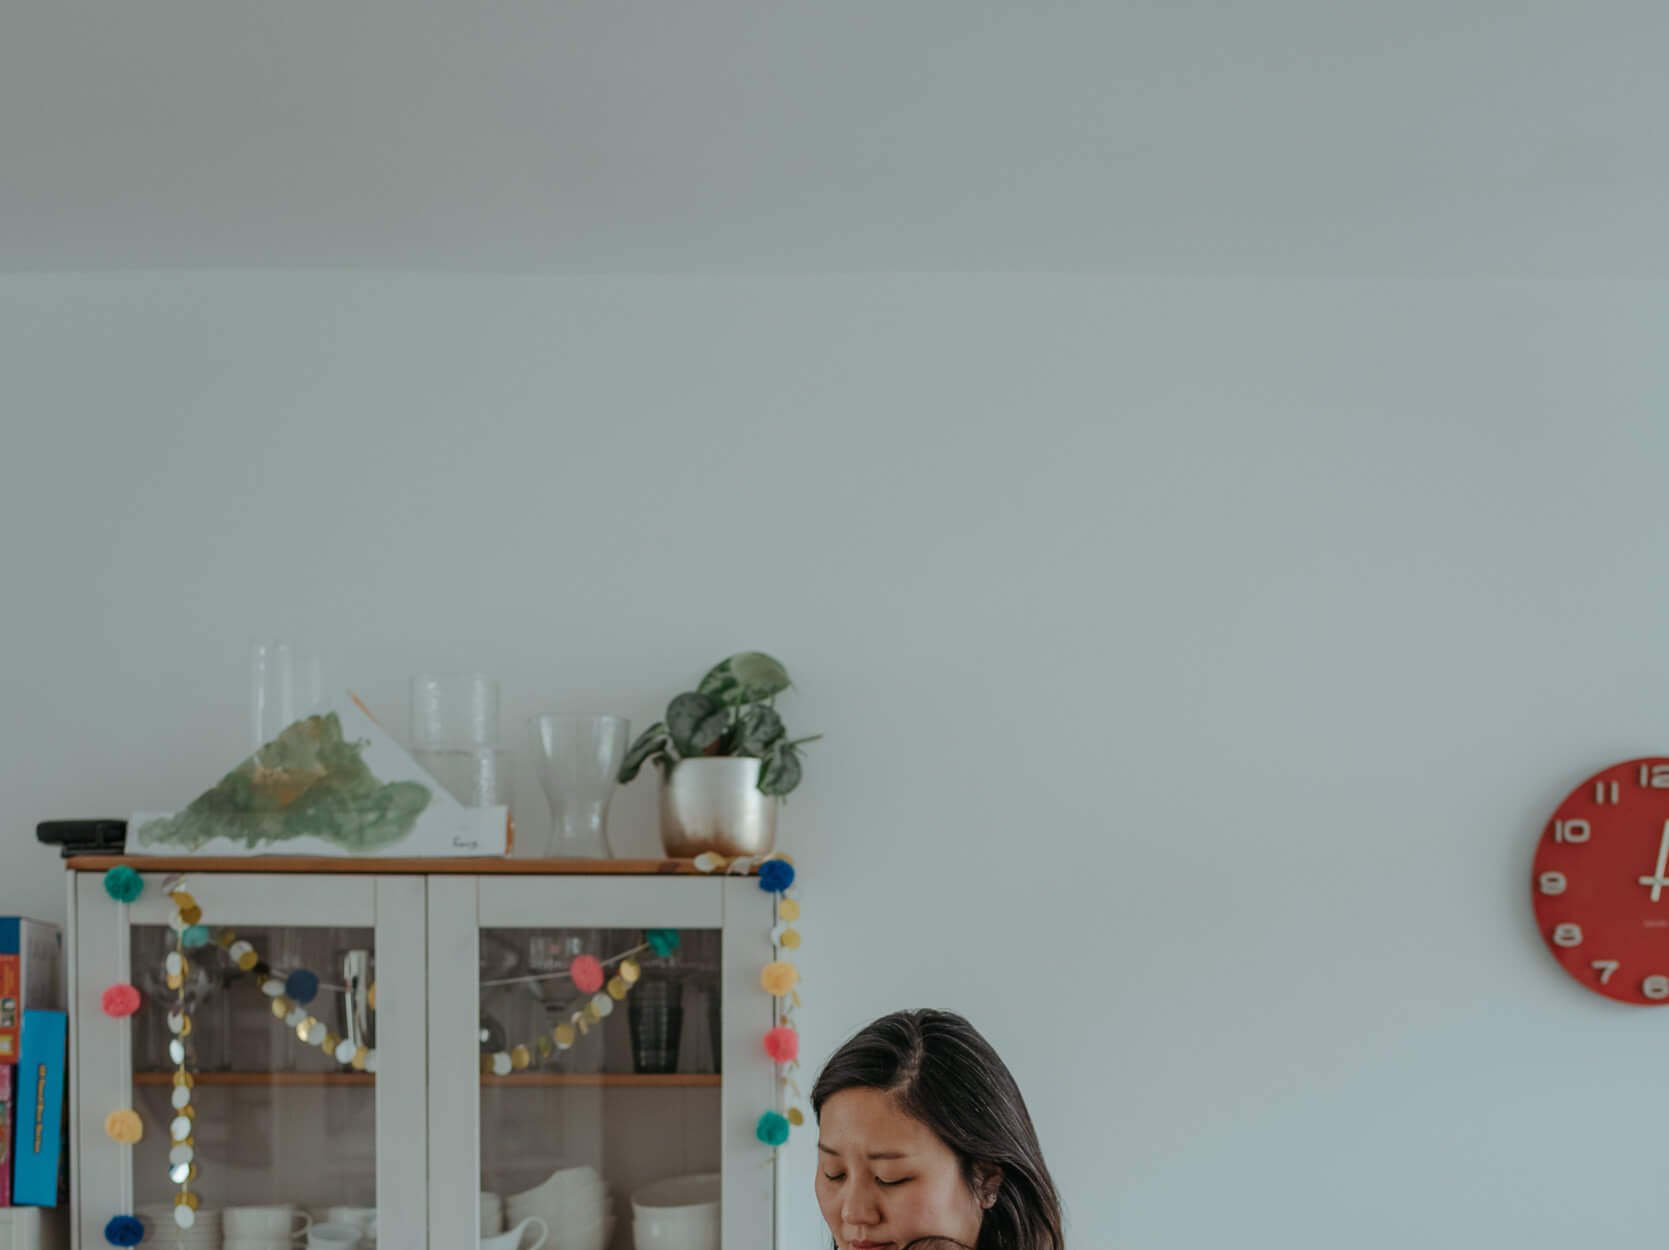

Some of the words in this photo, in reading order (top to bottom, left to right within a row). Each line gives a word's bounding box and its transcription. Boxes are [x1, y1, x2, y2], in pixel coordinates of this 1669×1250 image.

[1595, 781, 1619, 805] 11
[1554, 819, 1590, 843] 10
[1538, 871, 1567, 895] 9
[1553, 923, 1583, 947] 8
[1592, 960, 1620, 984] 7
